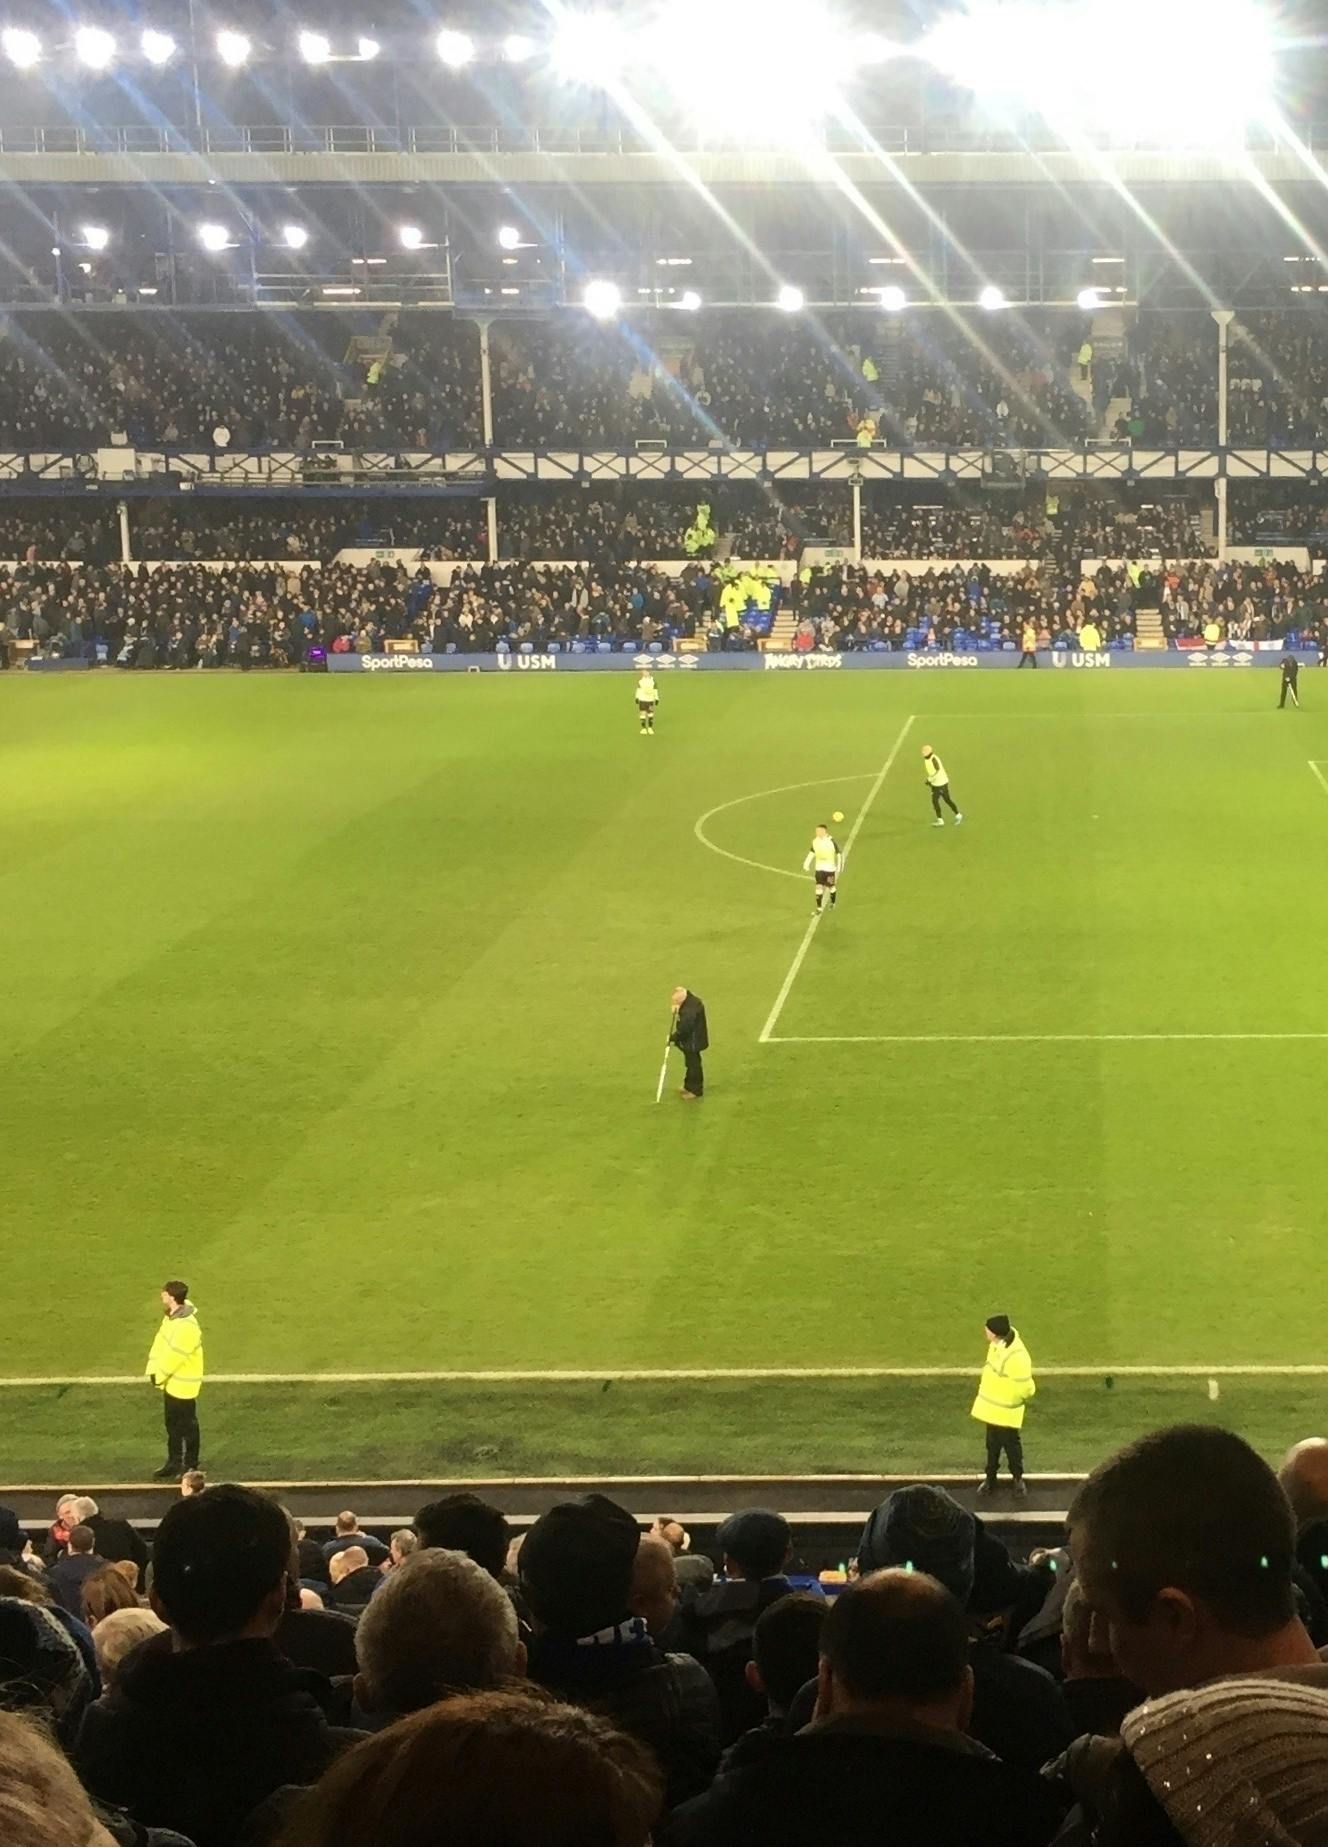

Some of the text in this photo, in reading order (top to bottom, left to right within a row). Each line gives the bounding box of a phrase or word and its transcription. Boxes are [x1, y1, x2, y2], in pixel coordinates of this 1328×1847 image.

[361, 655, 434, 671] SportPesa
[517, 655, 556, 669] USM
[907, 653, 978, 669] SportPesa
[1071, 652, 1111, 667] USM
